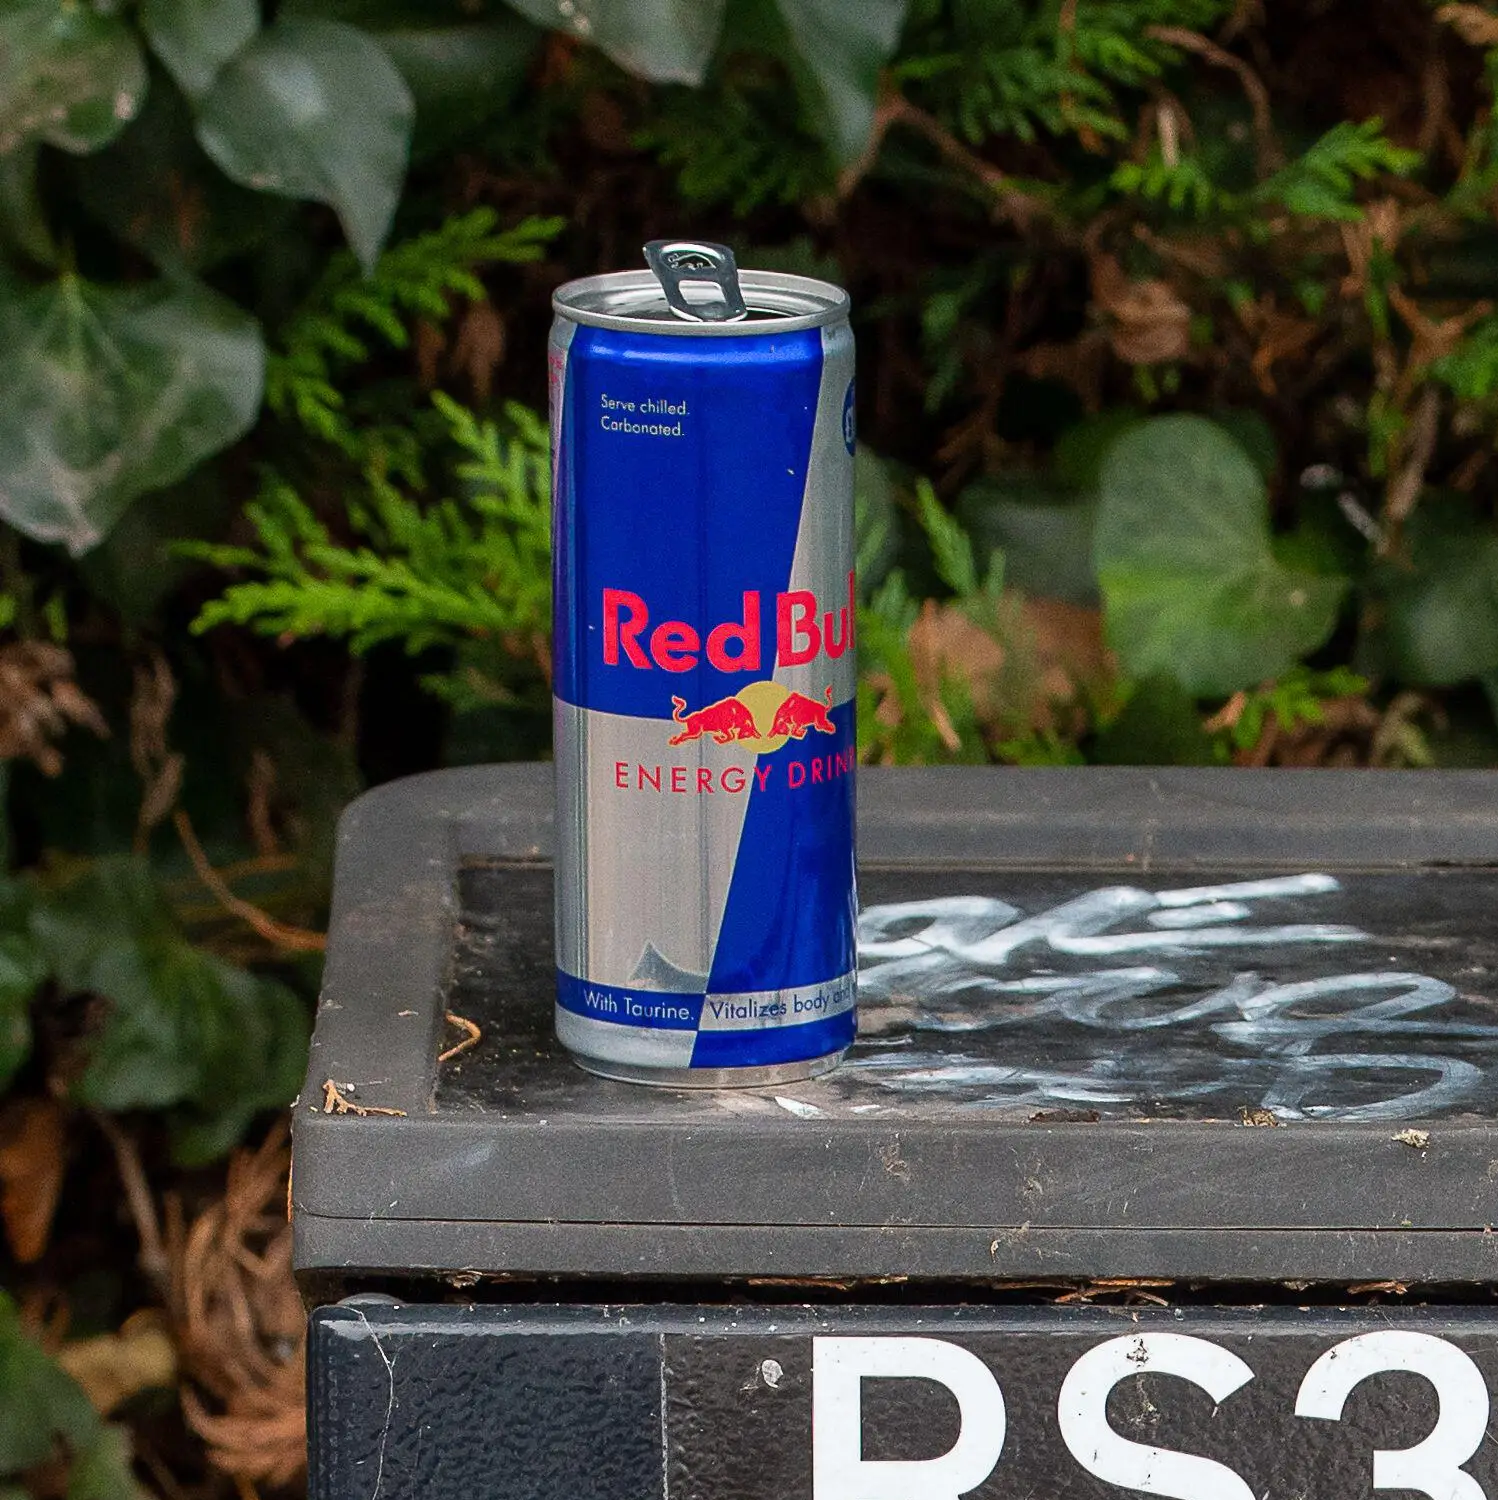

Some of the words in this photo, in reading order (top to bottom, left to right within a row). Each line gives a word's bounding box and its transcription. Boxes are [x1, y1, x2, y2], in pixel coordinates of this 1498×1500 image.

[600, 393, 635, 413] Serve
[639, 398, 690, 415] chilled.
[600, 416, 685, 437] Carbonated.
[602, 587, 760, 673] Red
[615, 761, 772, 793] ENERGY
[584, 990, 617, 1014] With
[623, 998, 694, 1020] Taurine.
[710, 998, 786, 1020] Vitalizes
[793, 989, 829, 1013] body
